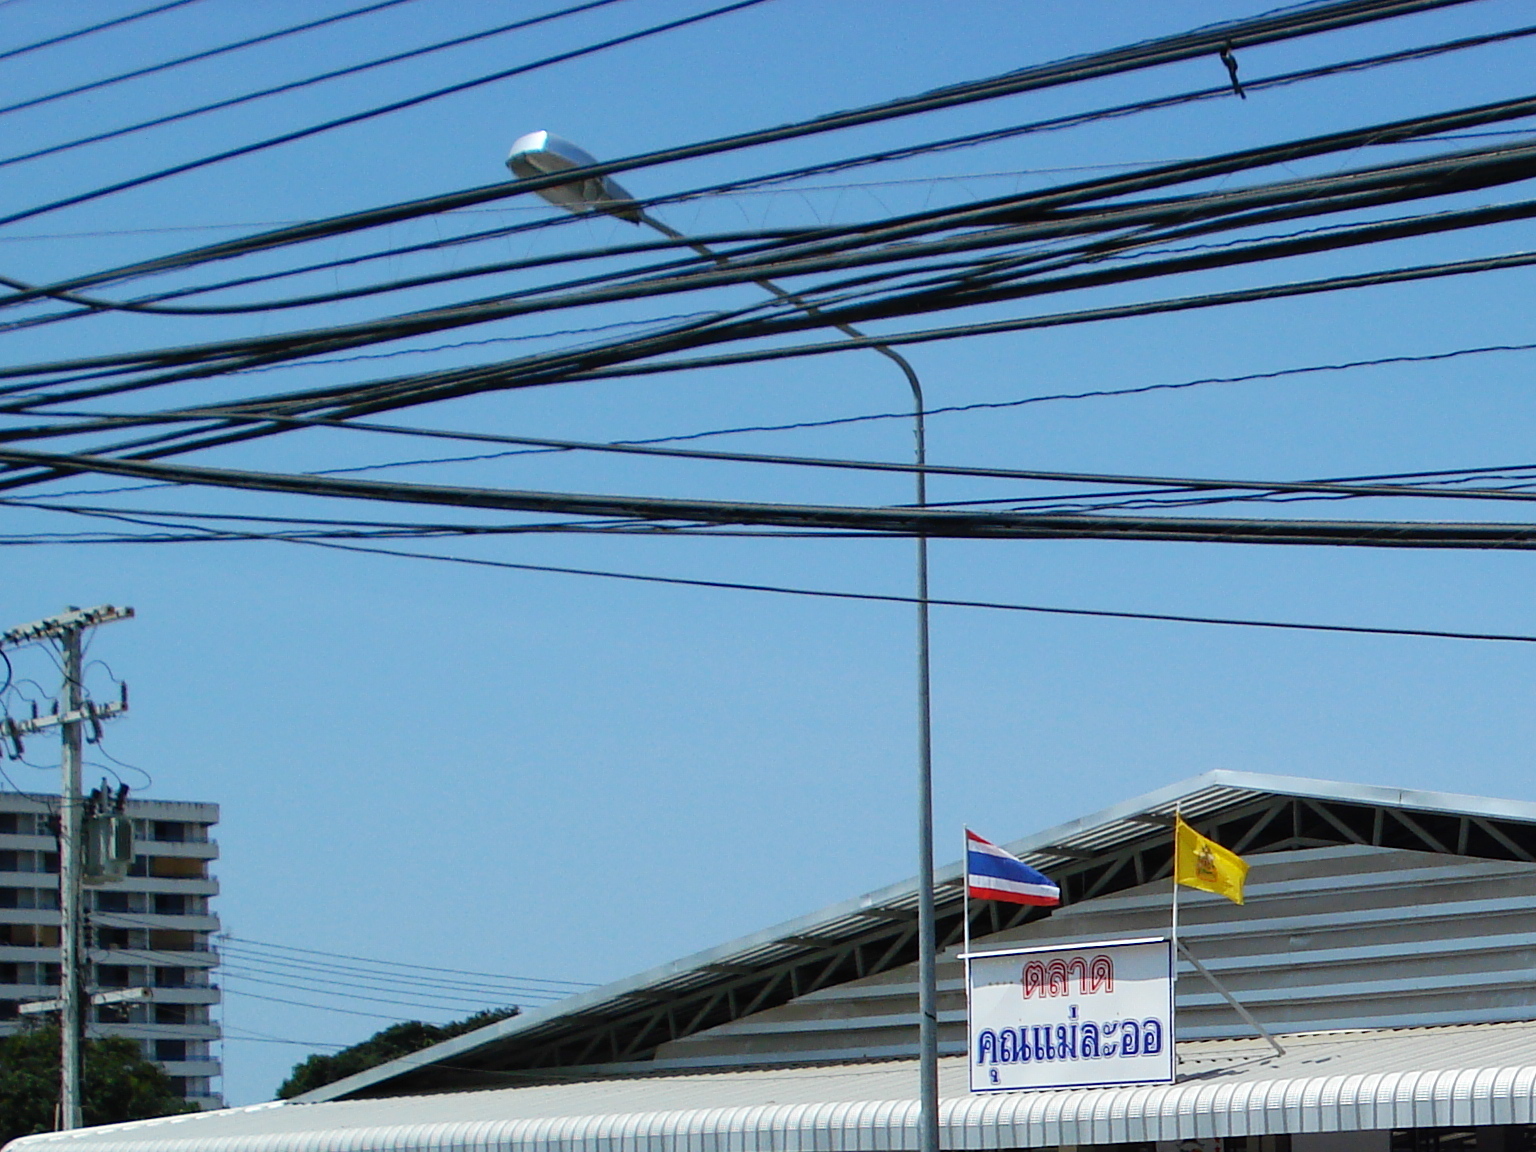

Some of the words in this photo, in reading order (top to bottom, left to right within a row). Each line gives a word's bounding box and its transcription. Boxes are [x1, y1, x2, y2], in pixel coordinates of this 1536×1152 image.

[1022, 954, 1115, 1000] ตลาด
[977, 1005, 1163, 1084] คุณแม่ละออ
